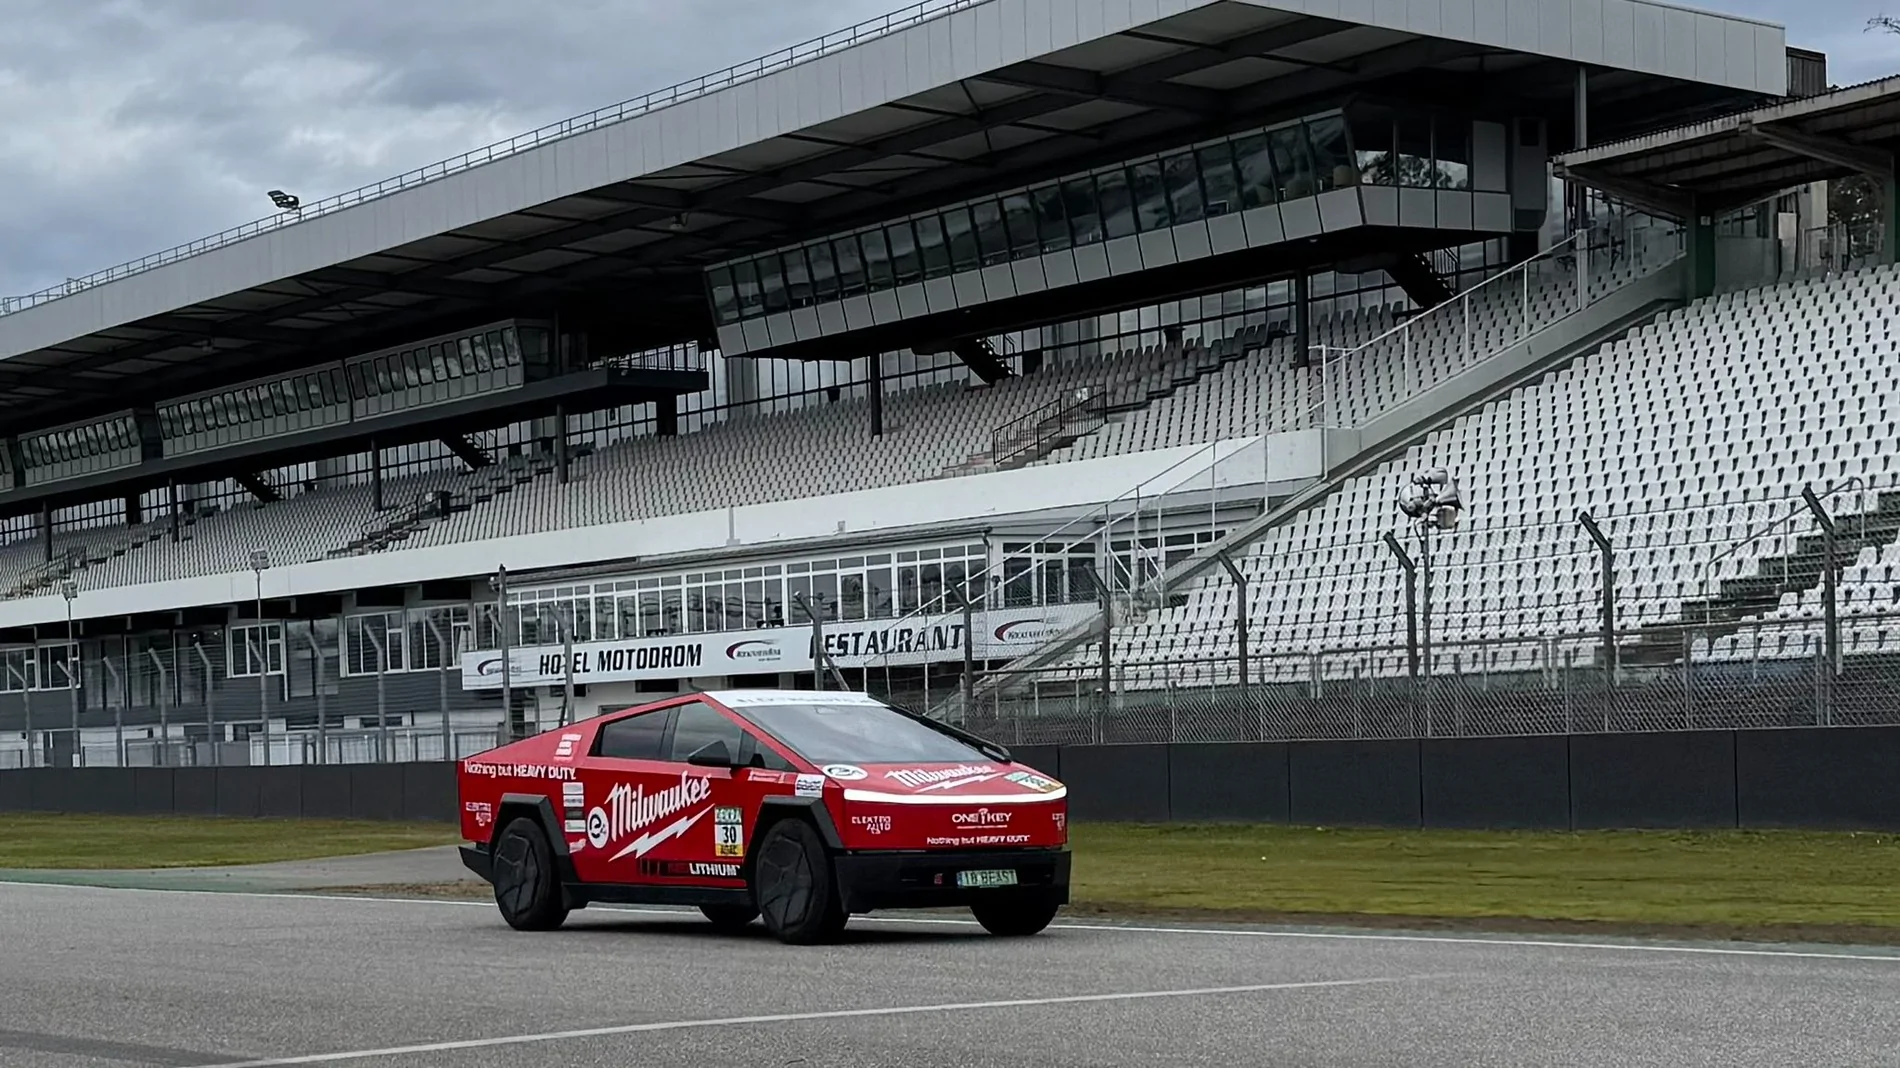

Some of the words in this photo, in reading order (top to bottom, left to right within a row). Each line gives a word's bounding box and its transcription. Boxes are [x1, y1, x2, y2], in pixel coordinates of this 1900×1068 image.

[539, 652, 591, 675] HOEL
[597, 643, 702, 671] MOTODROM
[513, 764, 546, 778] HEAVY
[884, 765, 996, 788] Milwaukee
[604, 770, 711, 842] Milwaukee
[952, 813, 979, 823] ONE
[987, 812, 1012, 823] KEY
[722, 826, 737, 844] 30
[981, 870, 1014, 884] BEAST
